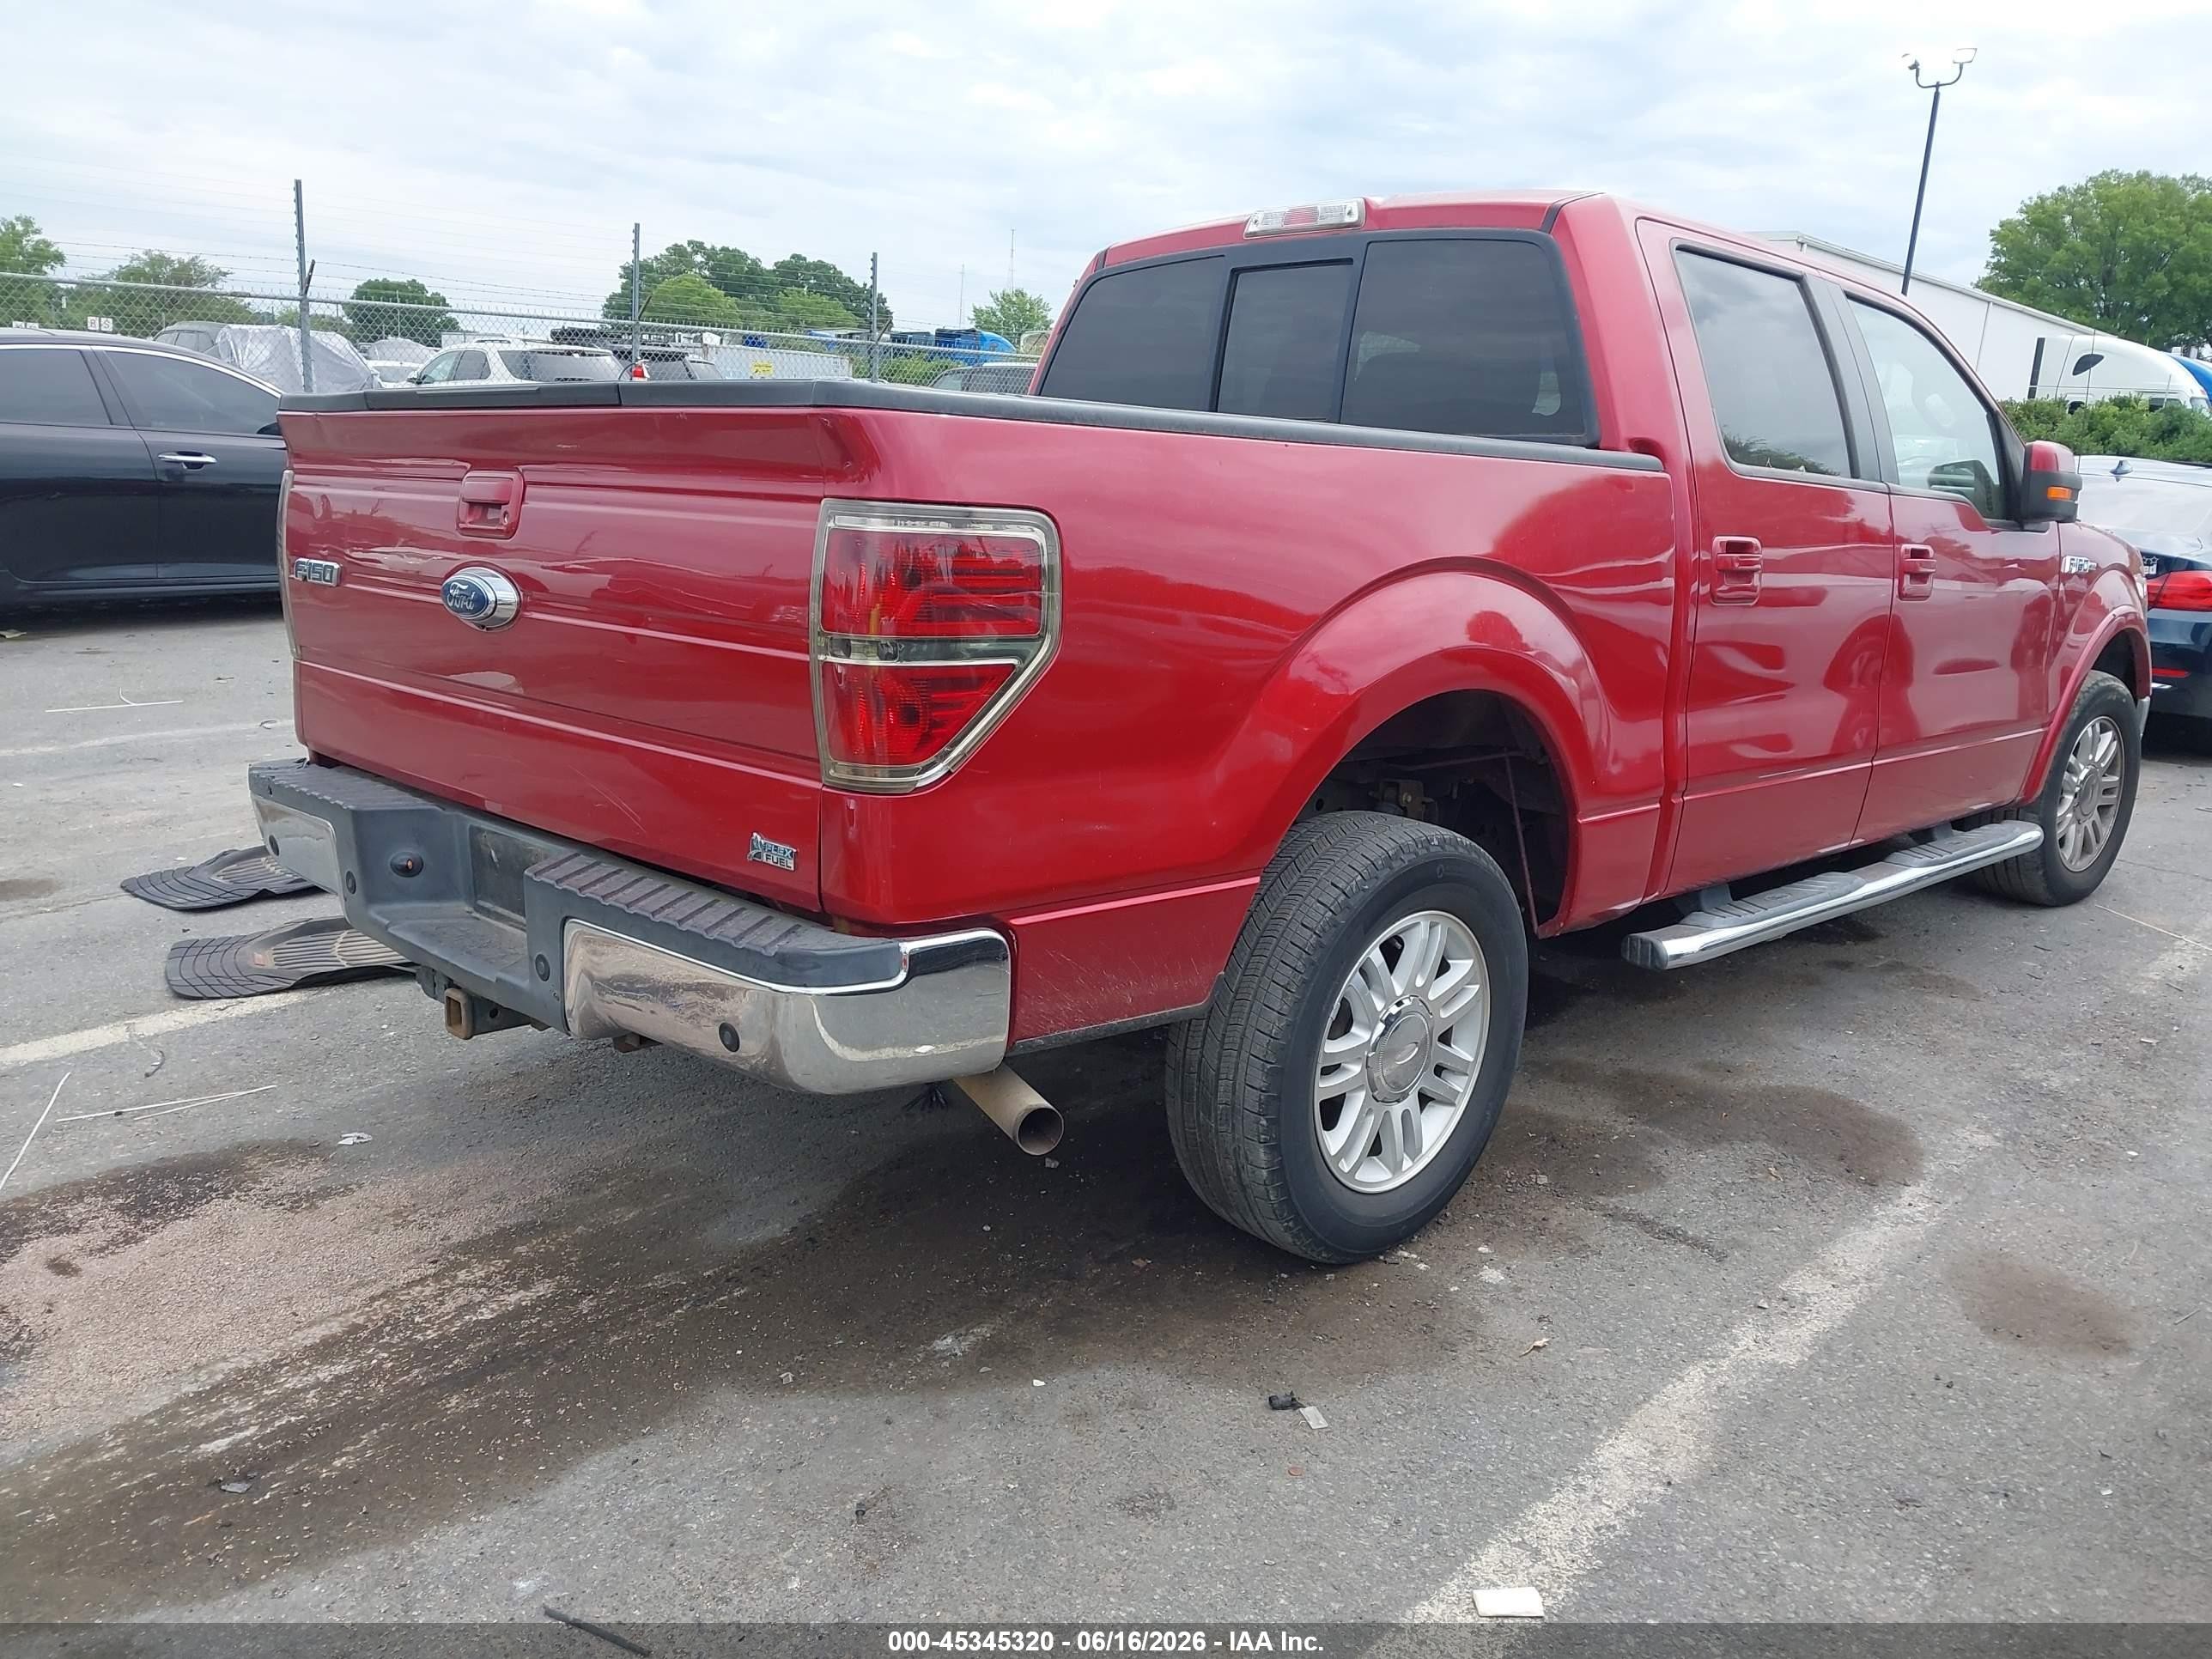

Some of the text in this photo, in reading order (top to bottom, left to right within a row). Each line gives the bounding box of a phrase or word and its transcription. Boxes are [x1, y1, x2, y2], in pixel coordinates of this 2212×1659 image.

[295, 559, 336, 586] F-150
[447, 581, 477, 611] Ford
[765, 842, 793, 860] FLEX
[765, 854, 793, 869] FUEL
